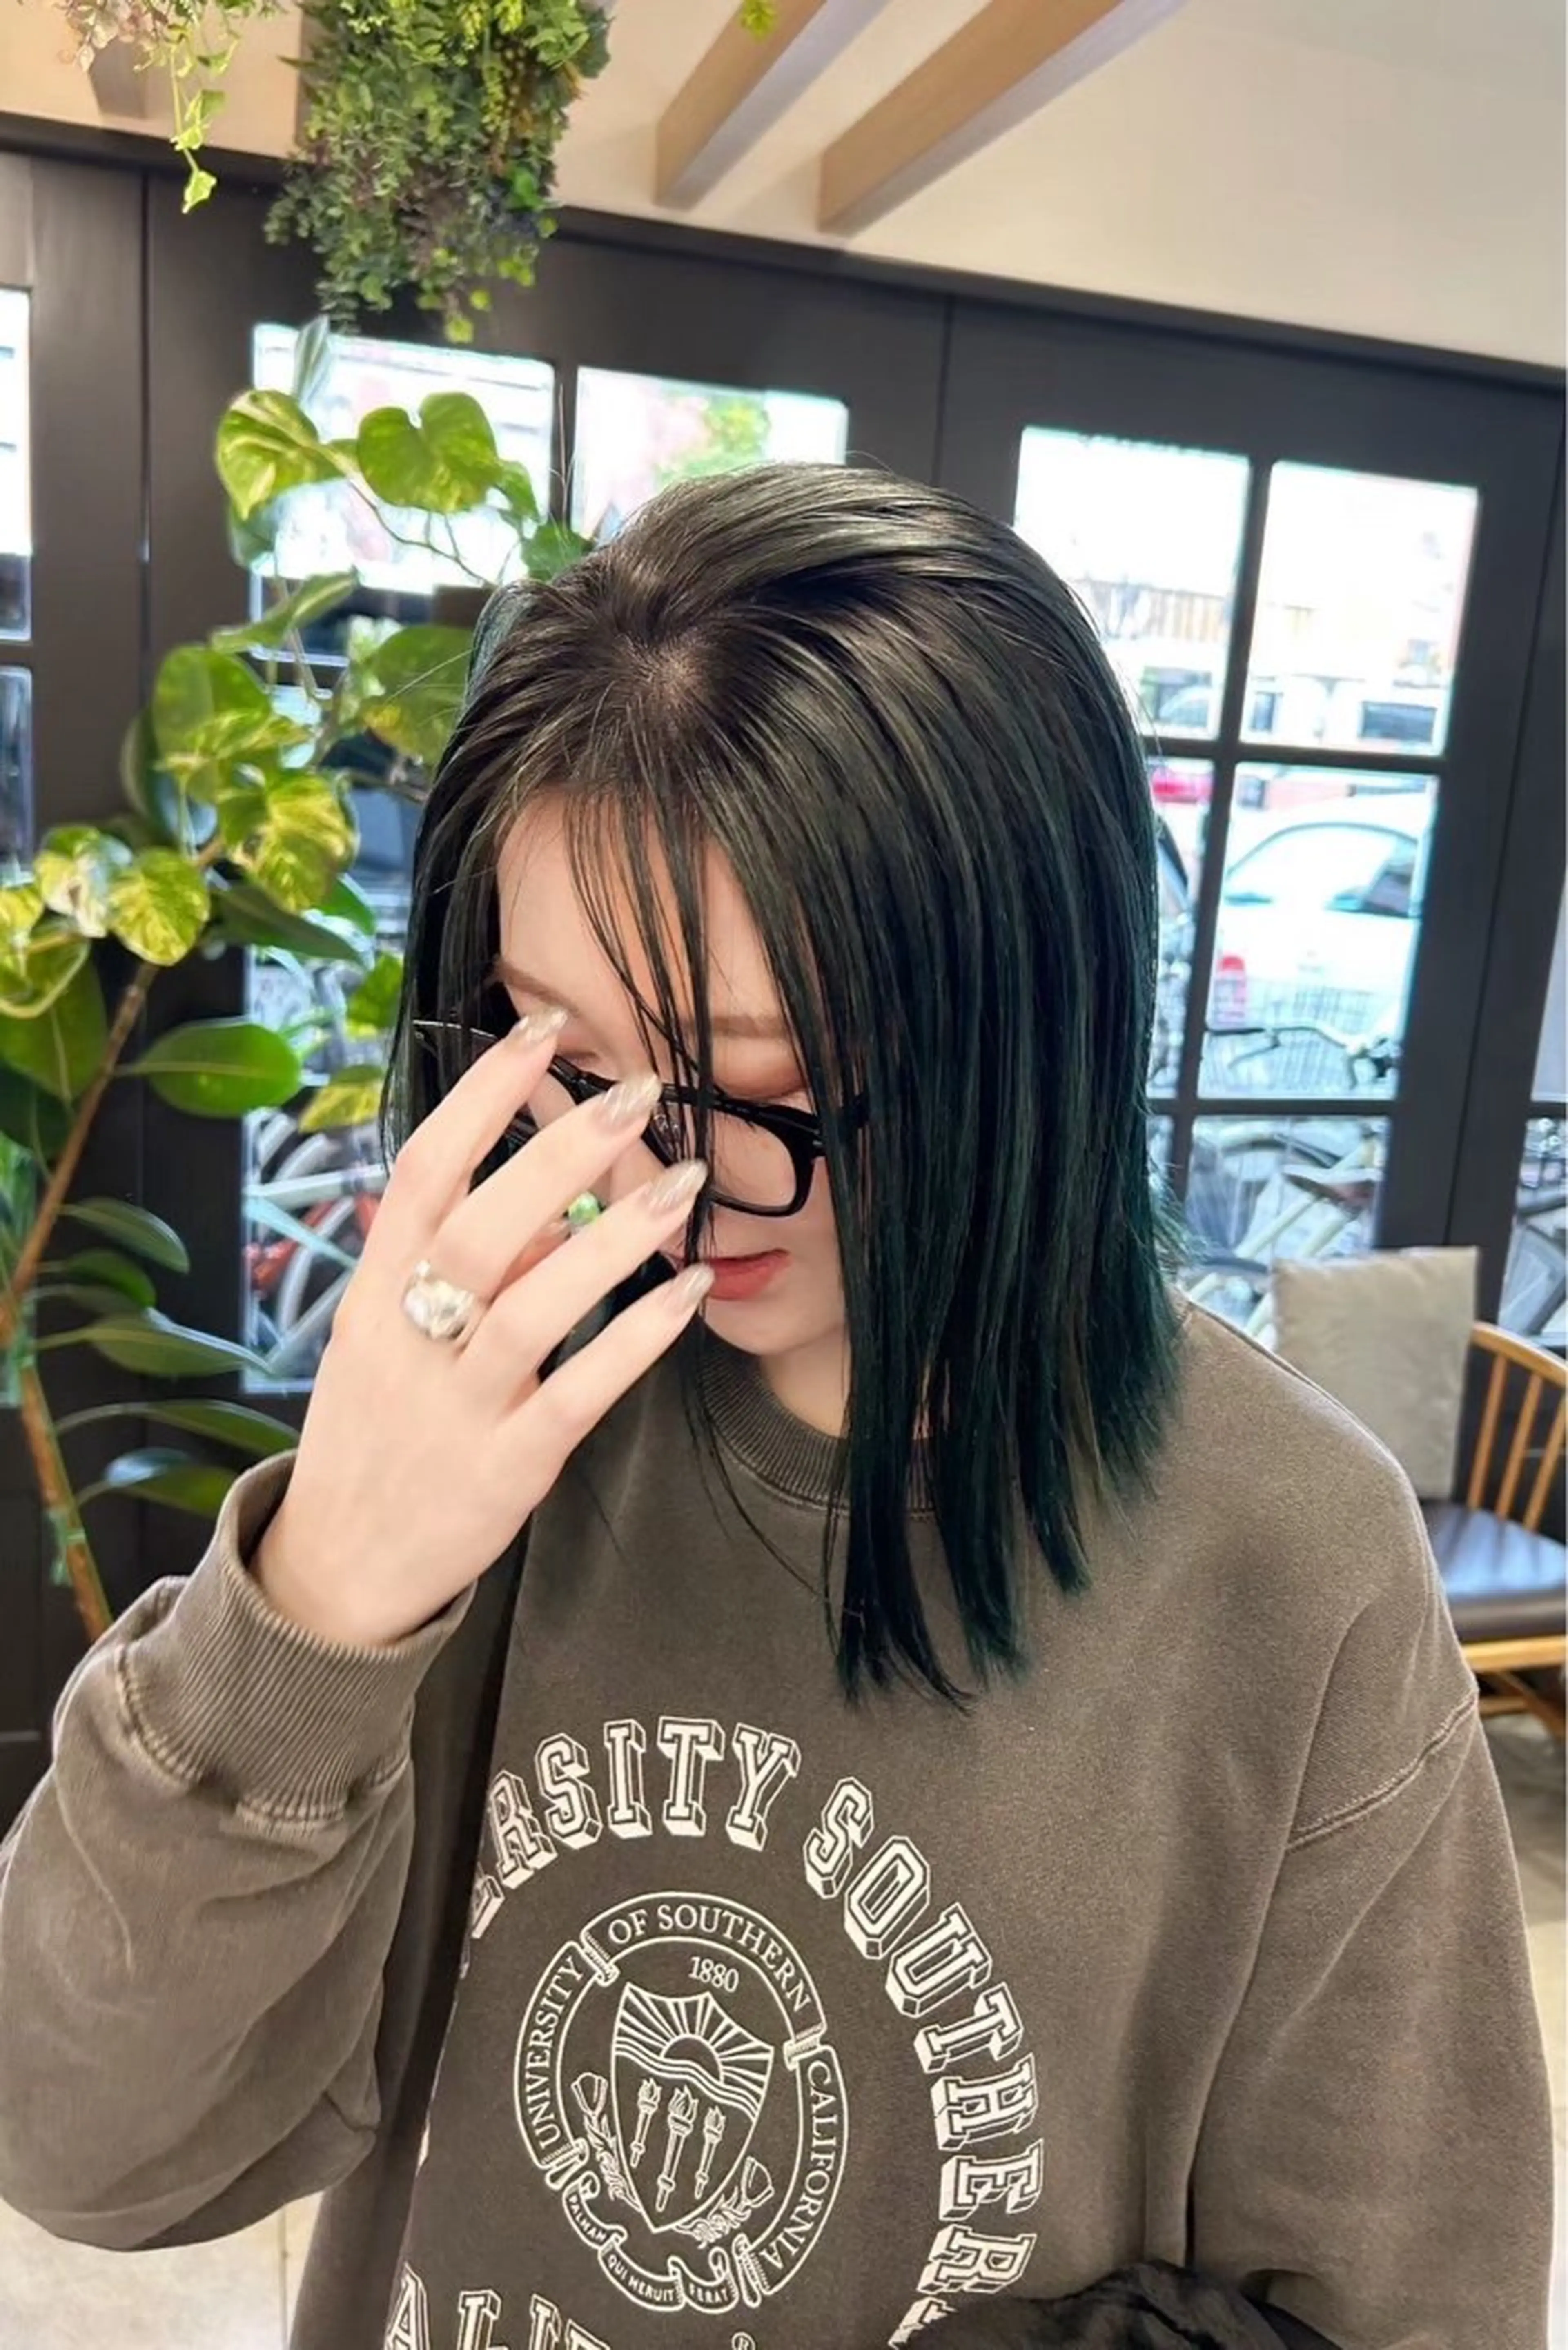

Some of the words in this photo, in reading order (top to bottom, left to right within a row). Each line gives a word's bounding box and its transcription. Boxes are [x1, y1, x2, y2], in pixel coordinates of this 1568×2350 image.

[688, 1956, 740, 1993] 1880
[526, 1957, 584, 2149] UNIVERSITY
[608, 1909, 648, 1945] OF
[657, 1904, 811, 2012] SOUTHERN
[762, 2061, 838, 2269] CALIFORNIA
